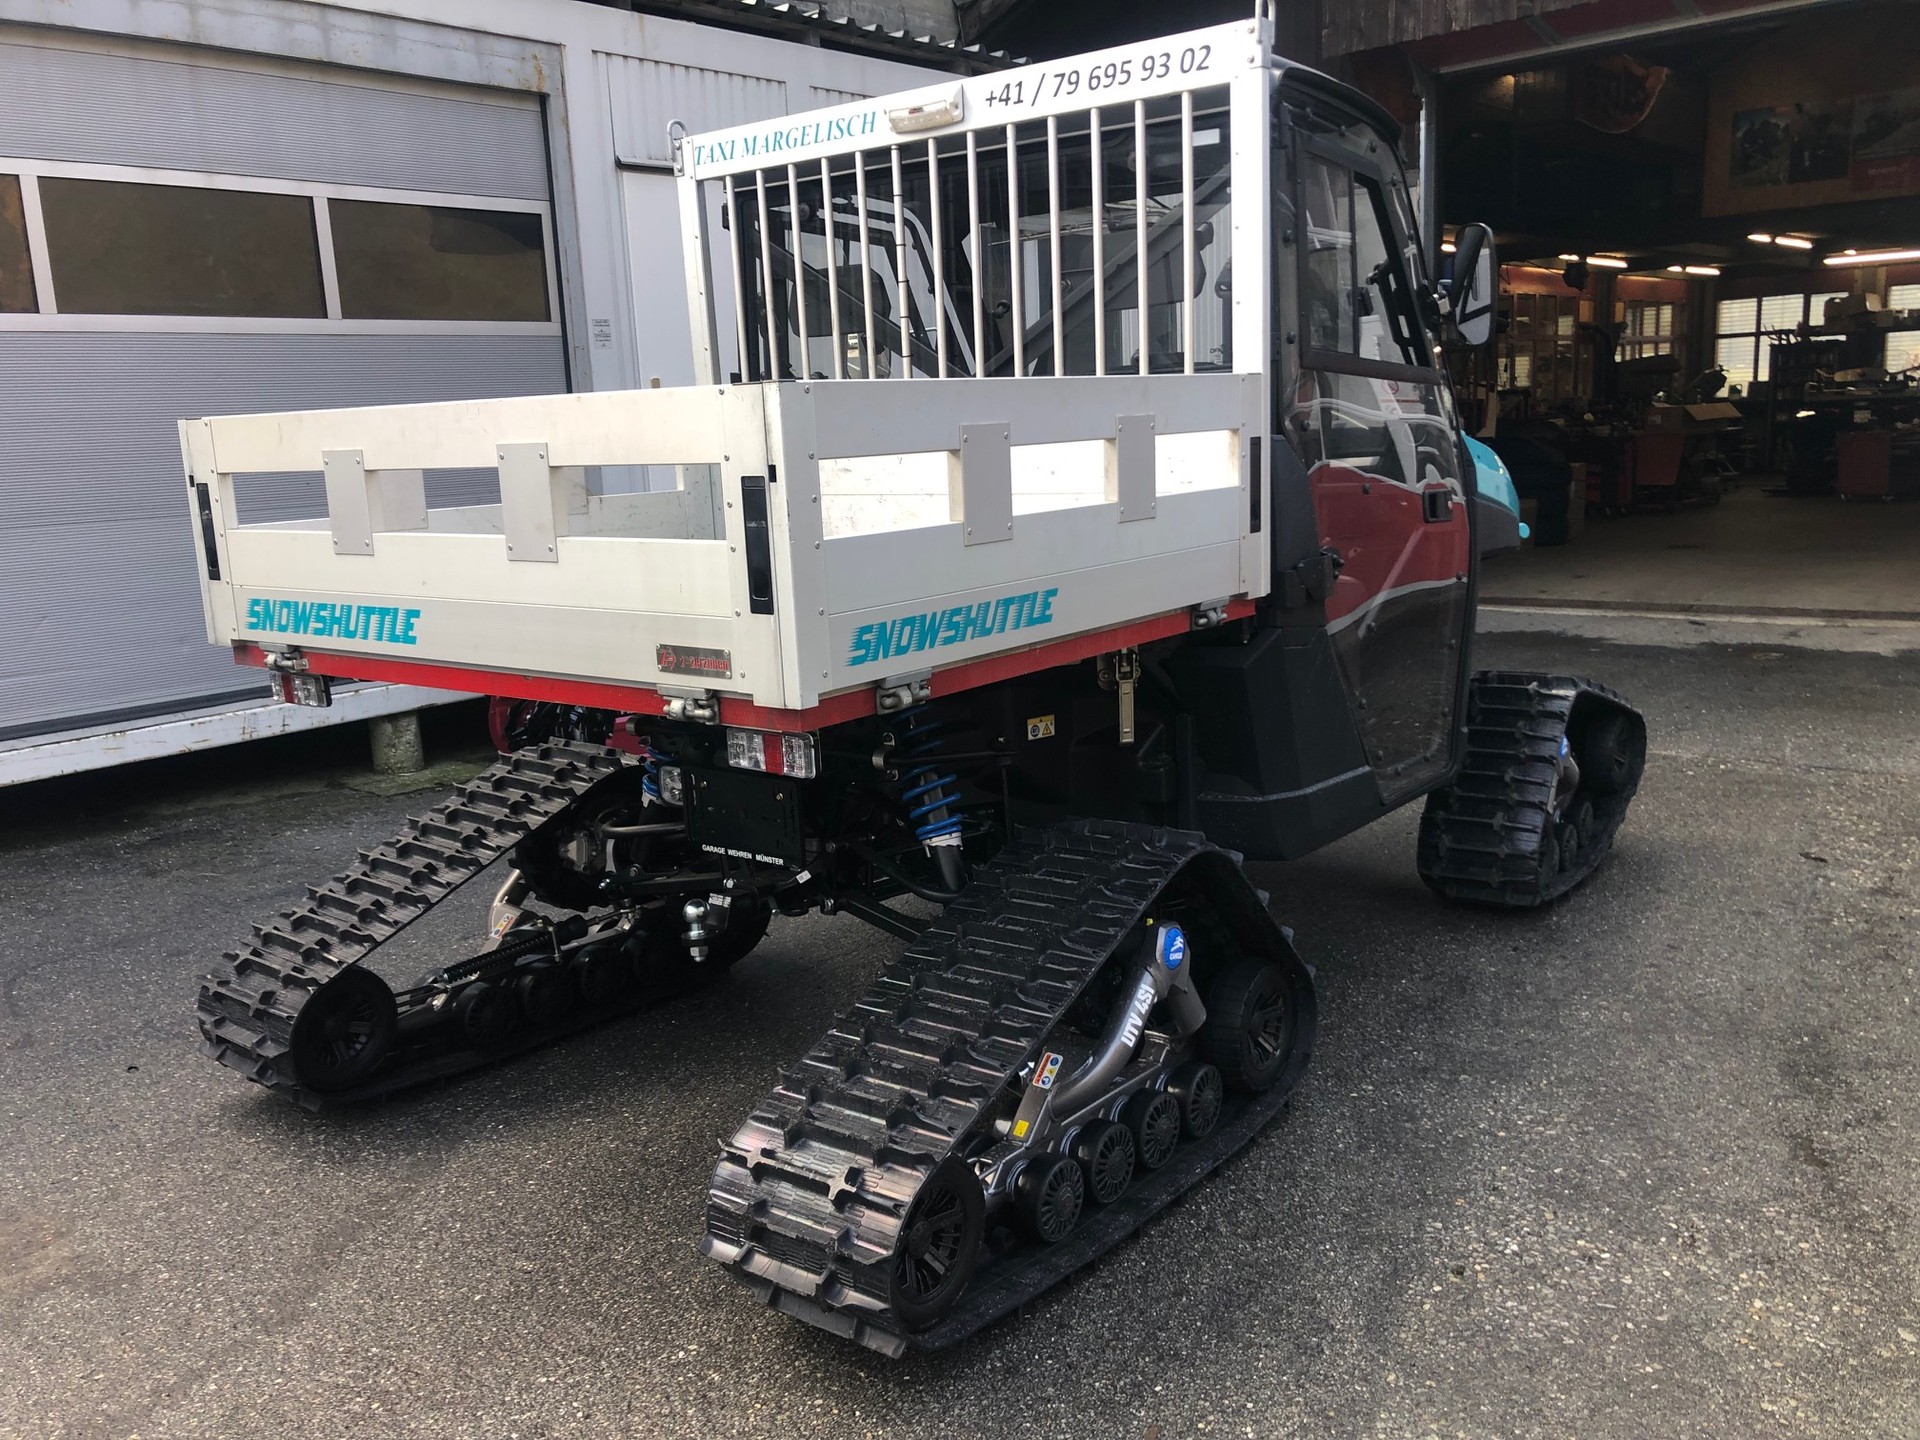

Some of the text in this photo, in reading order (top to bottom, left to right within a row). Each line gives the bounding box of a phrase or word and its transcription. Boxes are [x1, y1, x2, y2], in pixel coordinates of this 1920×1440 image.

[985, 45, 1211, 107] +41 / 79 695 93 02
[694, 111, 876, 166] TAXI MARGELISCH
[245, 598, 421, 645] SNOWSHUTTLE
[844, 588, 1058, 667] SNOWSHUTTLE
[702, 844, 784, 866] GARAGE WEHREN MÜNSTER
[1121, 1011, 1143, 1047] UTV
